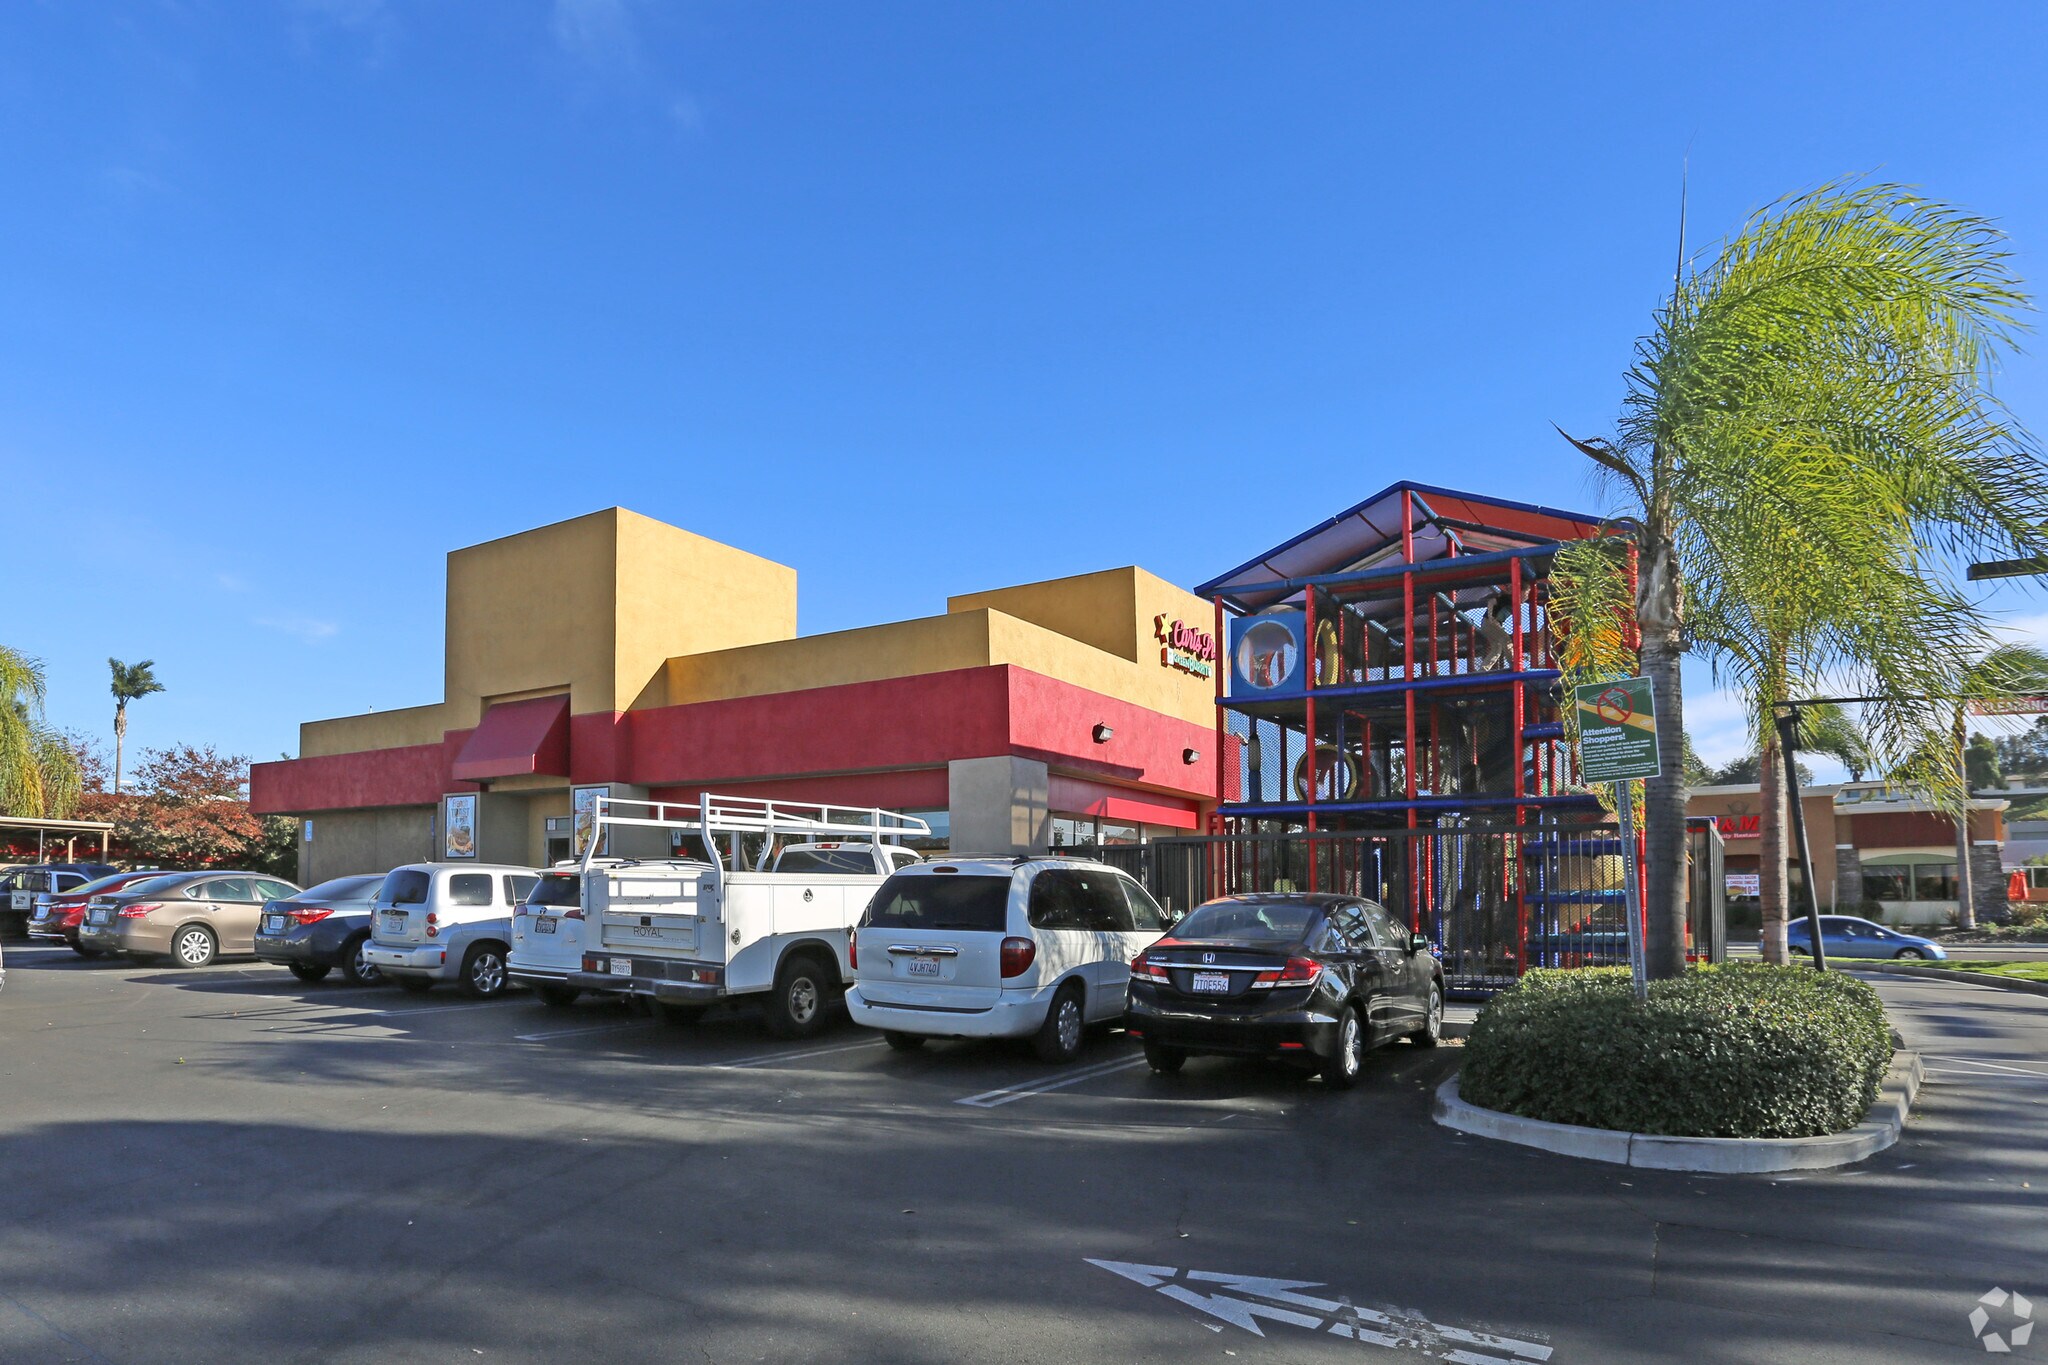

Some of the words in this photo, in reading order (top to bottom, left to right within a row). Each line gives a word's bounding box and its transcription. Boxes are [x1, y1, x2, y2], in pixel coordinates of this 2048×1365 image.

[1582, 726, 1622, 737] Attention
[1582, 733, 1626, 744] Shoppers!
[1722, 818, 1737, 832] &
[1739, 815, 1761, 831] M
[1733, 831, 1761, 839] Restaur
[633, 926, 664, 938] ROYAL
